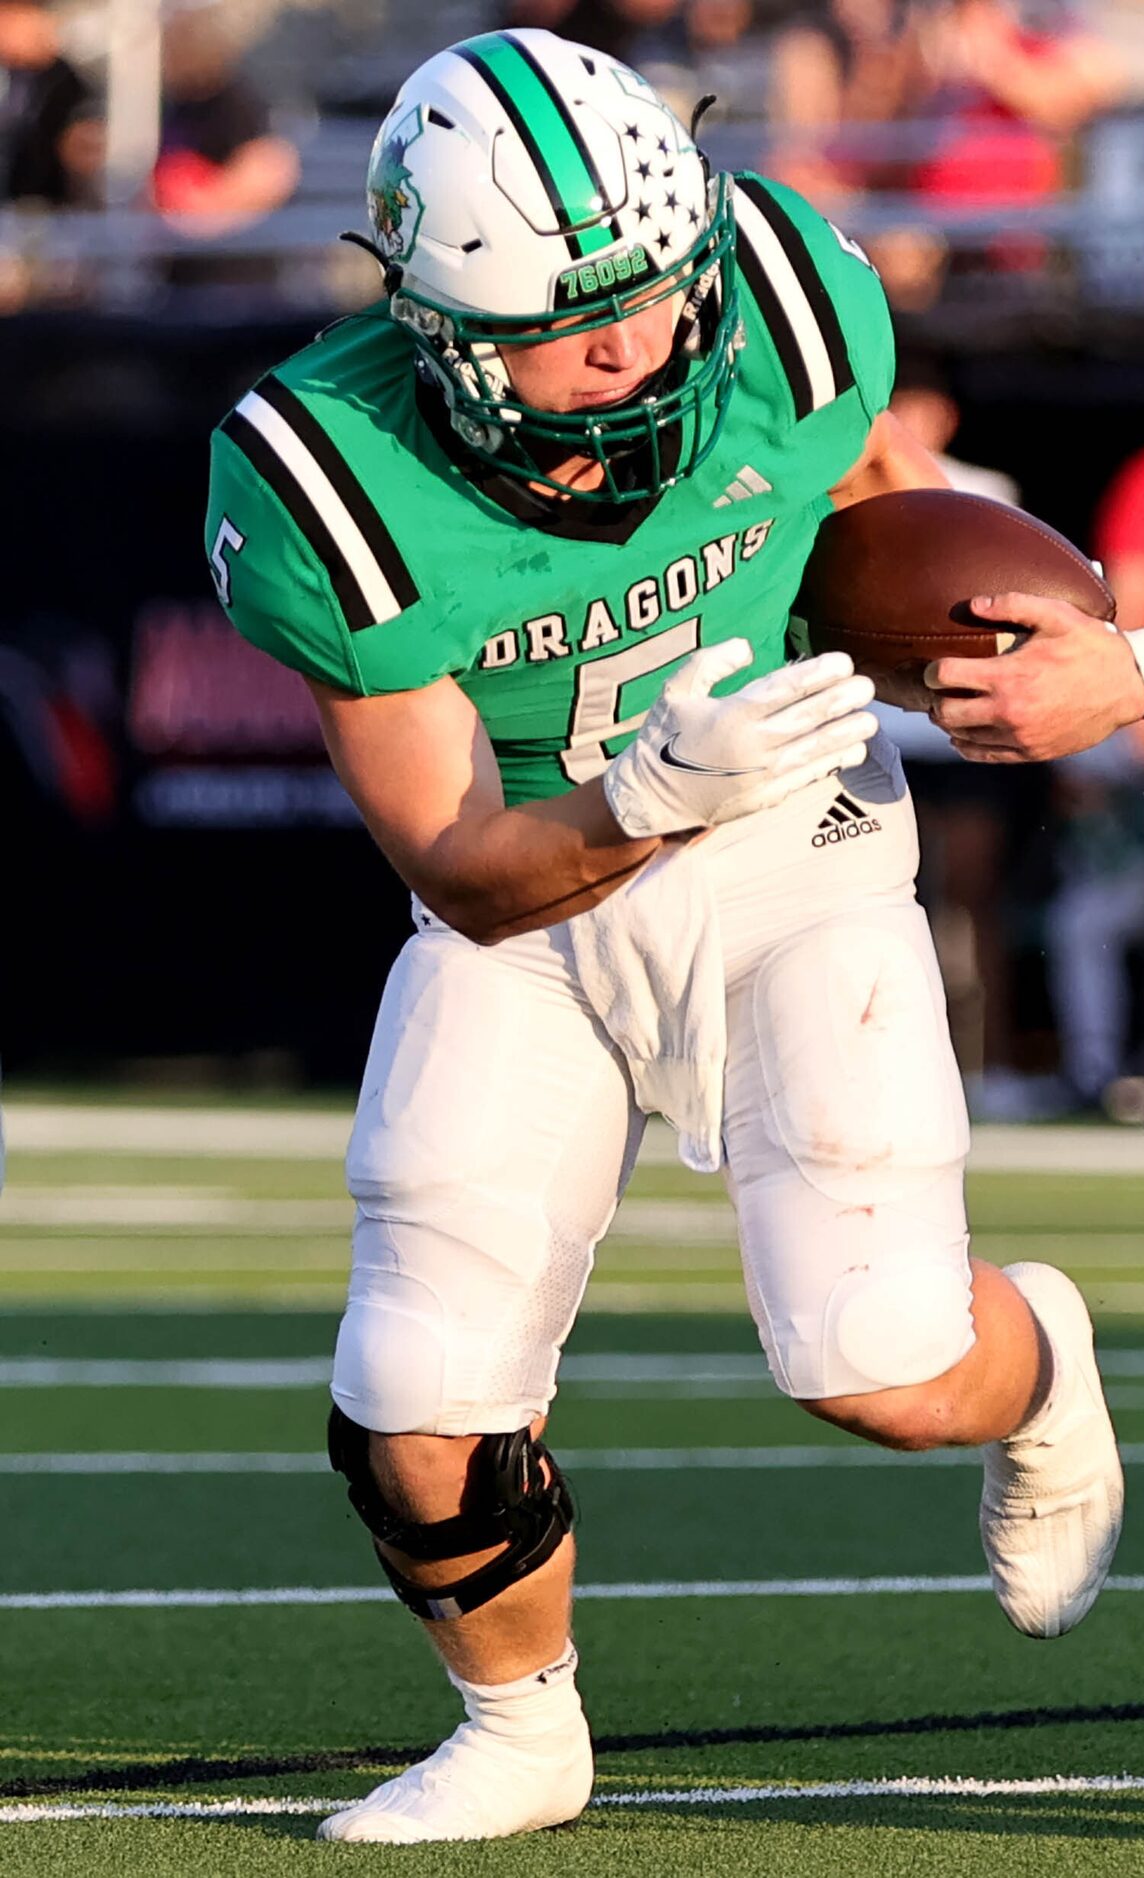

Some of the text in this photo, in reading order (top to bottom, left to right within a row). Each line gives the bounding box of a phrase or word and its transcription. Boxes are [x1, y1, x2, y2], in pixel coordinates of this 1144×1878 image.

[560, 247, 649, 299] 76092
[479, 517, 776, 670] DRAGONS
[811, 819, 882, 848] adidas
